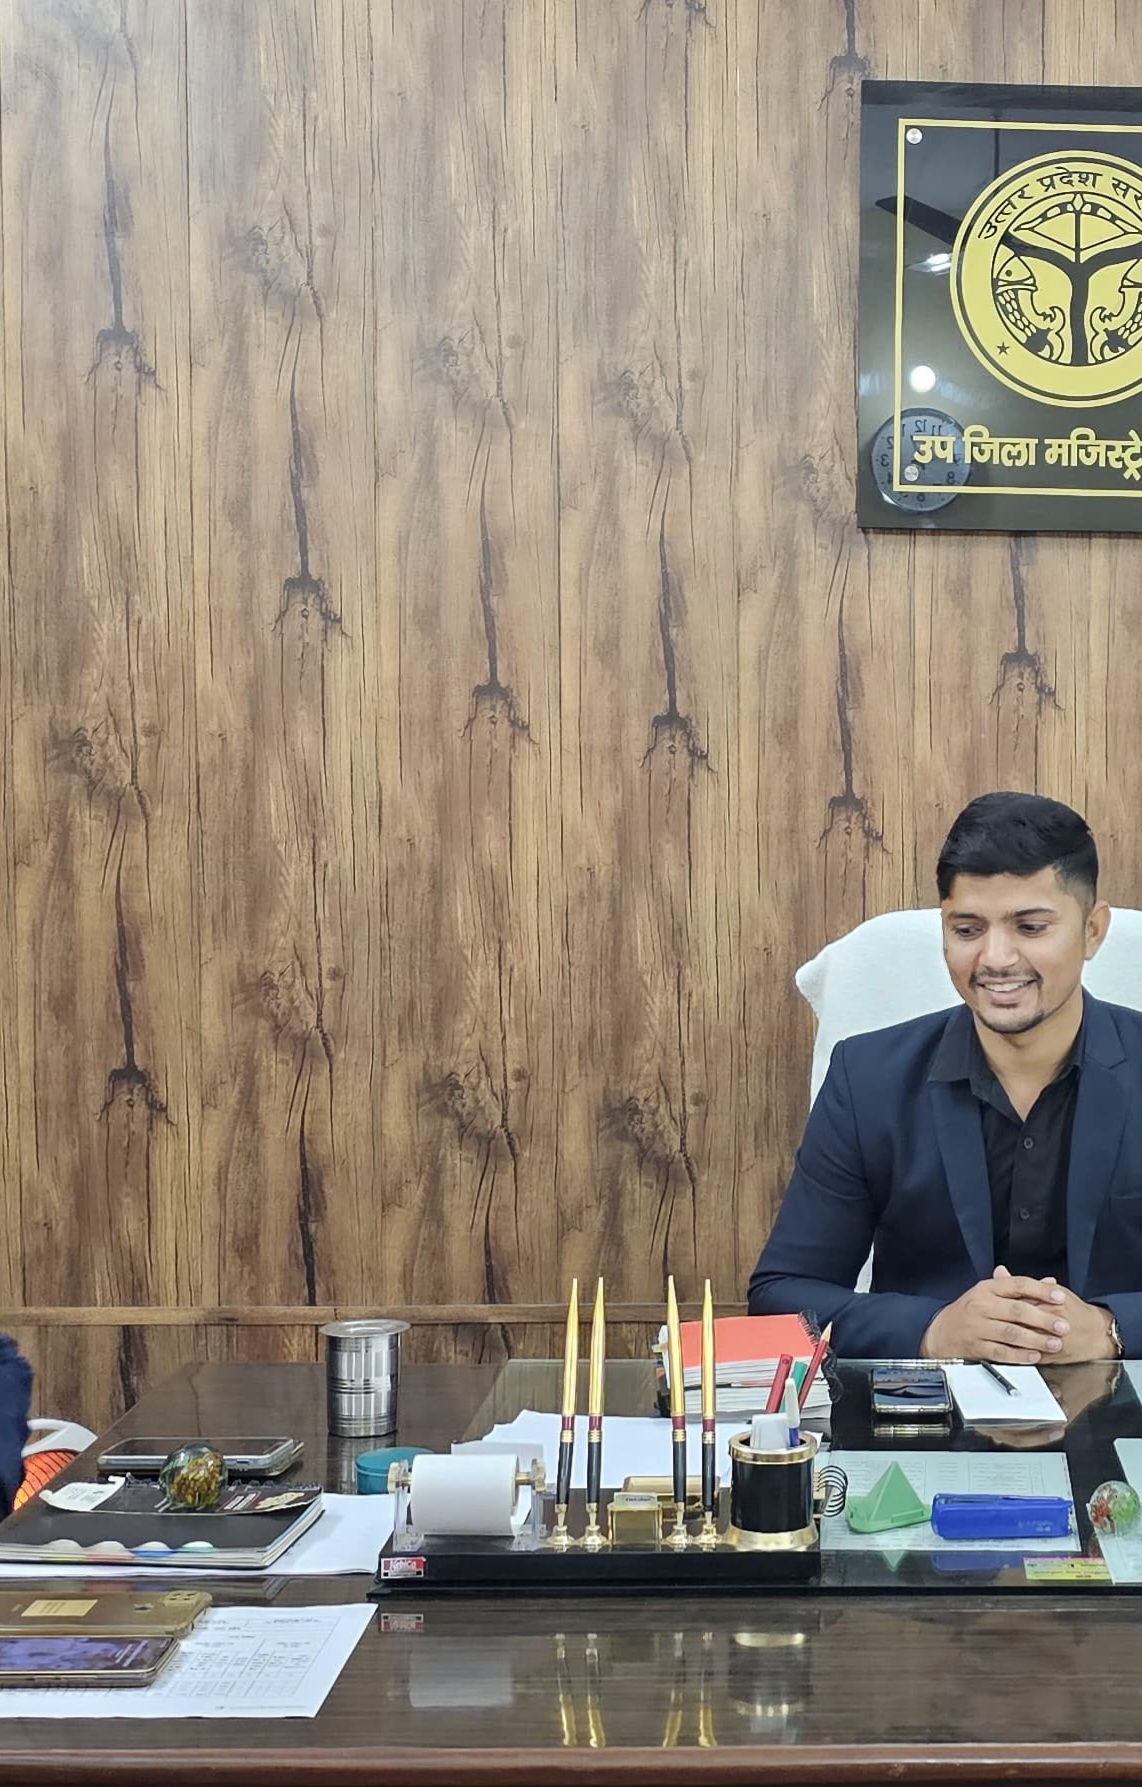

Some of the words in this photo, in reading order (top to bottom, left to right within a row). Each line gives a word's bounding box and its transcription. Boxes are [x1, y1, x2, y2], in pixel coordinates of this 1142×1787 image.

[977, 184, 1033, 239] उत्तर
[1036, 167, 1103, 192] प्रदेश
[912, 435, 956, 463] उप
[962, 424, 1039, 466] जिला
